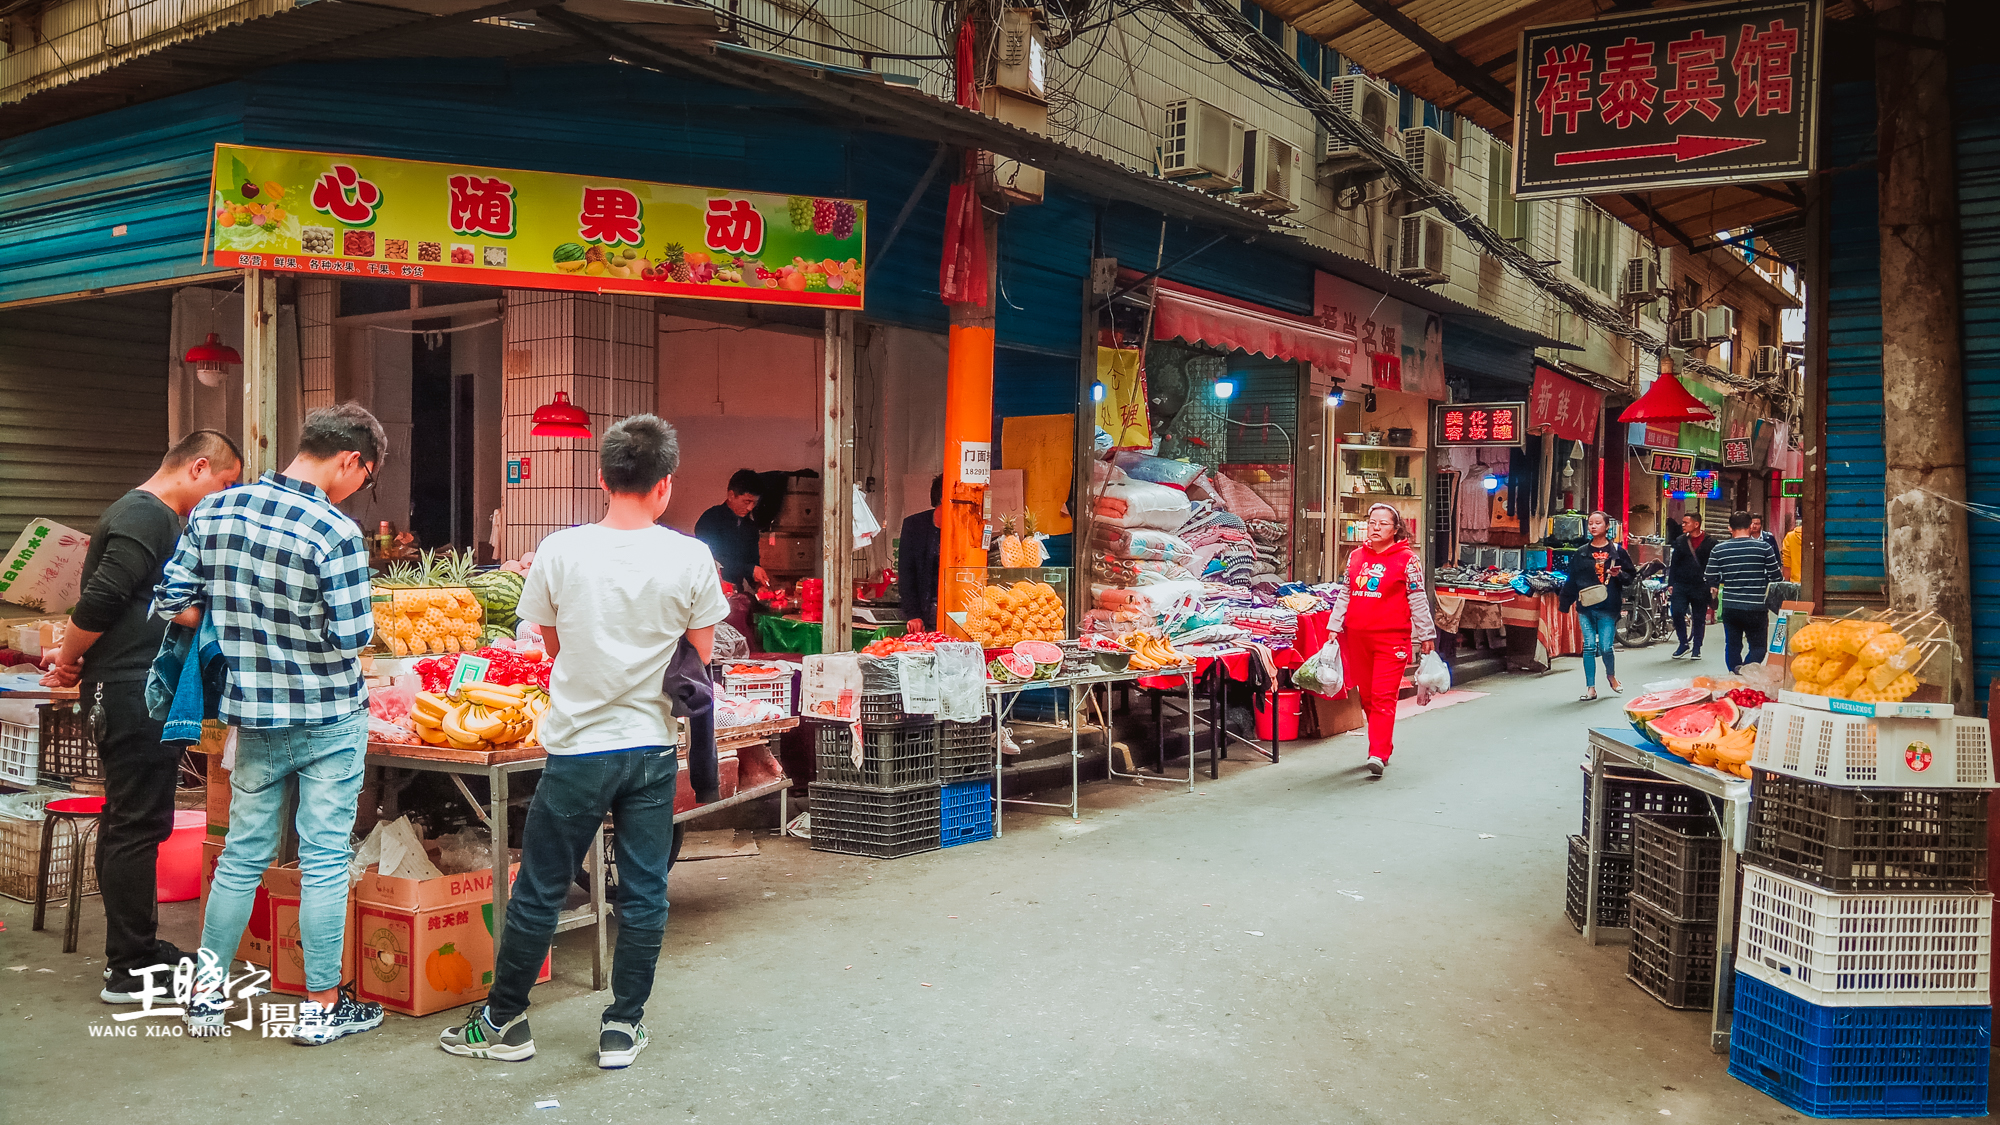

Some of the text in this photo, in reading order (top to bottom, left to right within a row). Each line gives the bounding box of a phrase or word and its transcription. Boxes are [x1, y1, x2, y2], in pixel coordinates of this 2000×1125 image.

[1535, 19, 1798, 136] 祥泰宾馆
[310, 163, 768, 257] 心随果动
[1535, 379, 1586, 433] 新鲜人
[1445, 411, 1464, 441] 美容
[1468, 410, 1488, 440] 化妆
[1653, 455, 1691, 474] 重庆小面
[1726, 441, 1750, 464] 鞋
[1667, 476, 1714, 494] 减肥养生
[427, 910, 469, 932] 纯天然
